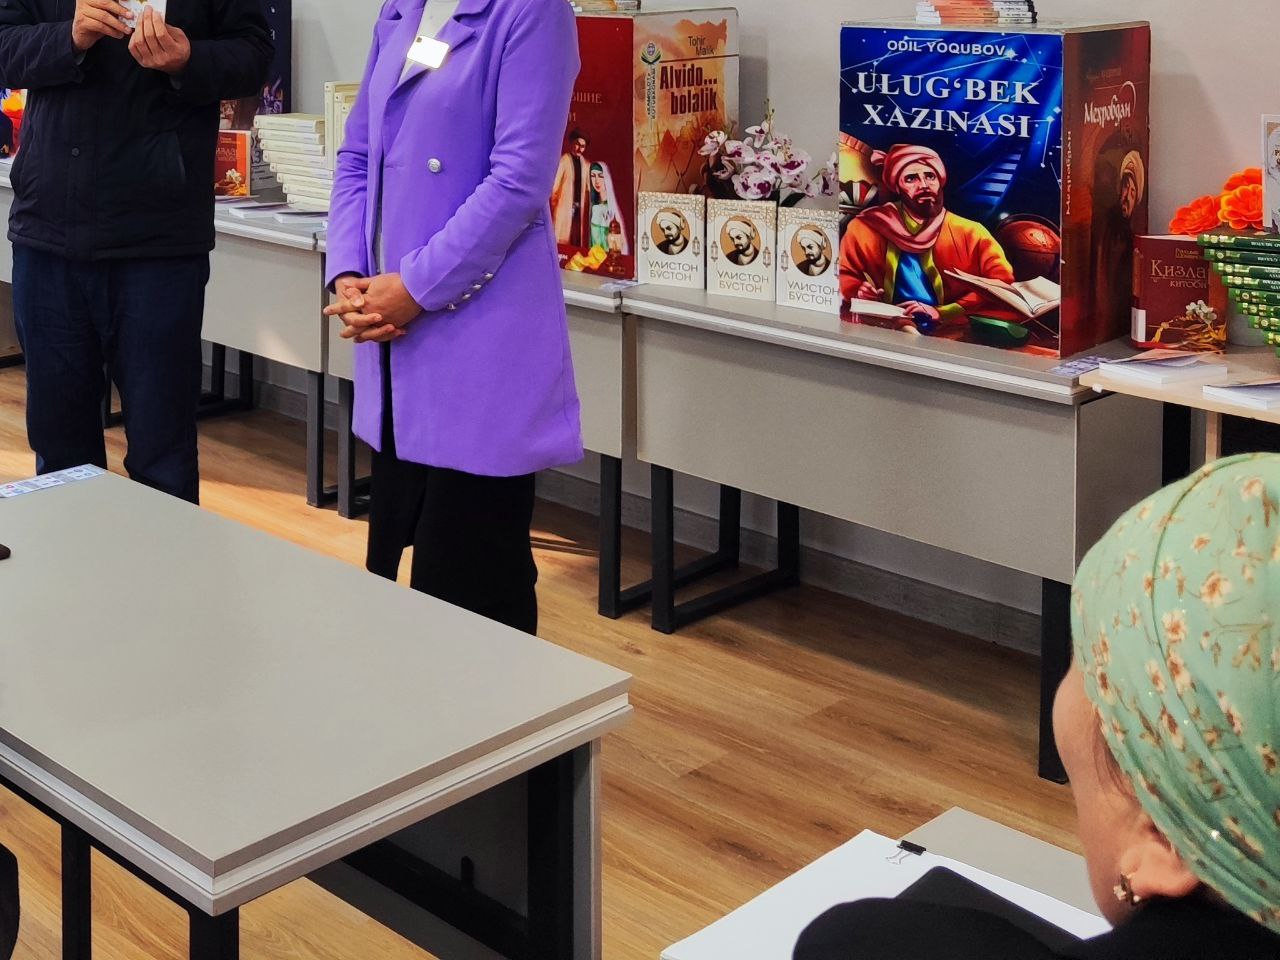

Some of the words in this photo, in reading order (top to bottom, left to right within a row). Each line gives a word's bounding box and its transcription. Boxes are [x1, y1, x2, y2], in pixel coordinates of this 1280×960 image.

[687, 35, 706, 47] Tohir
[886, 40, 922, 52] ODIL
[926, 41, 1007, 57] YOQUBOV
[660, 63, 718, 90] Alvido...
[670, 87, 717, 116] bolalik
[862, 103, 1031, 138] XAZINASI
[649, 270, 692, 282] БУСТОН
[719, 281, 762, 293] БУСТОН
[788, 291, 832, 306] БУСТОН
